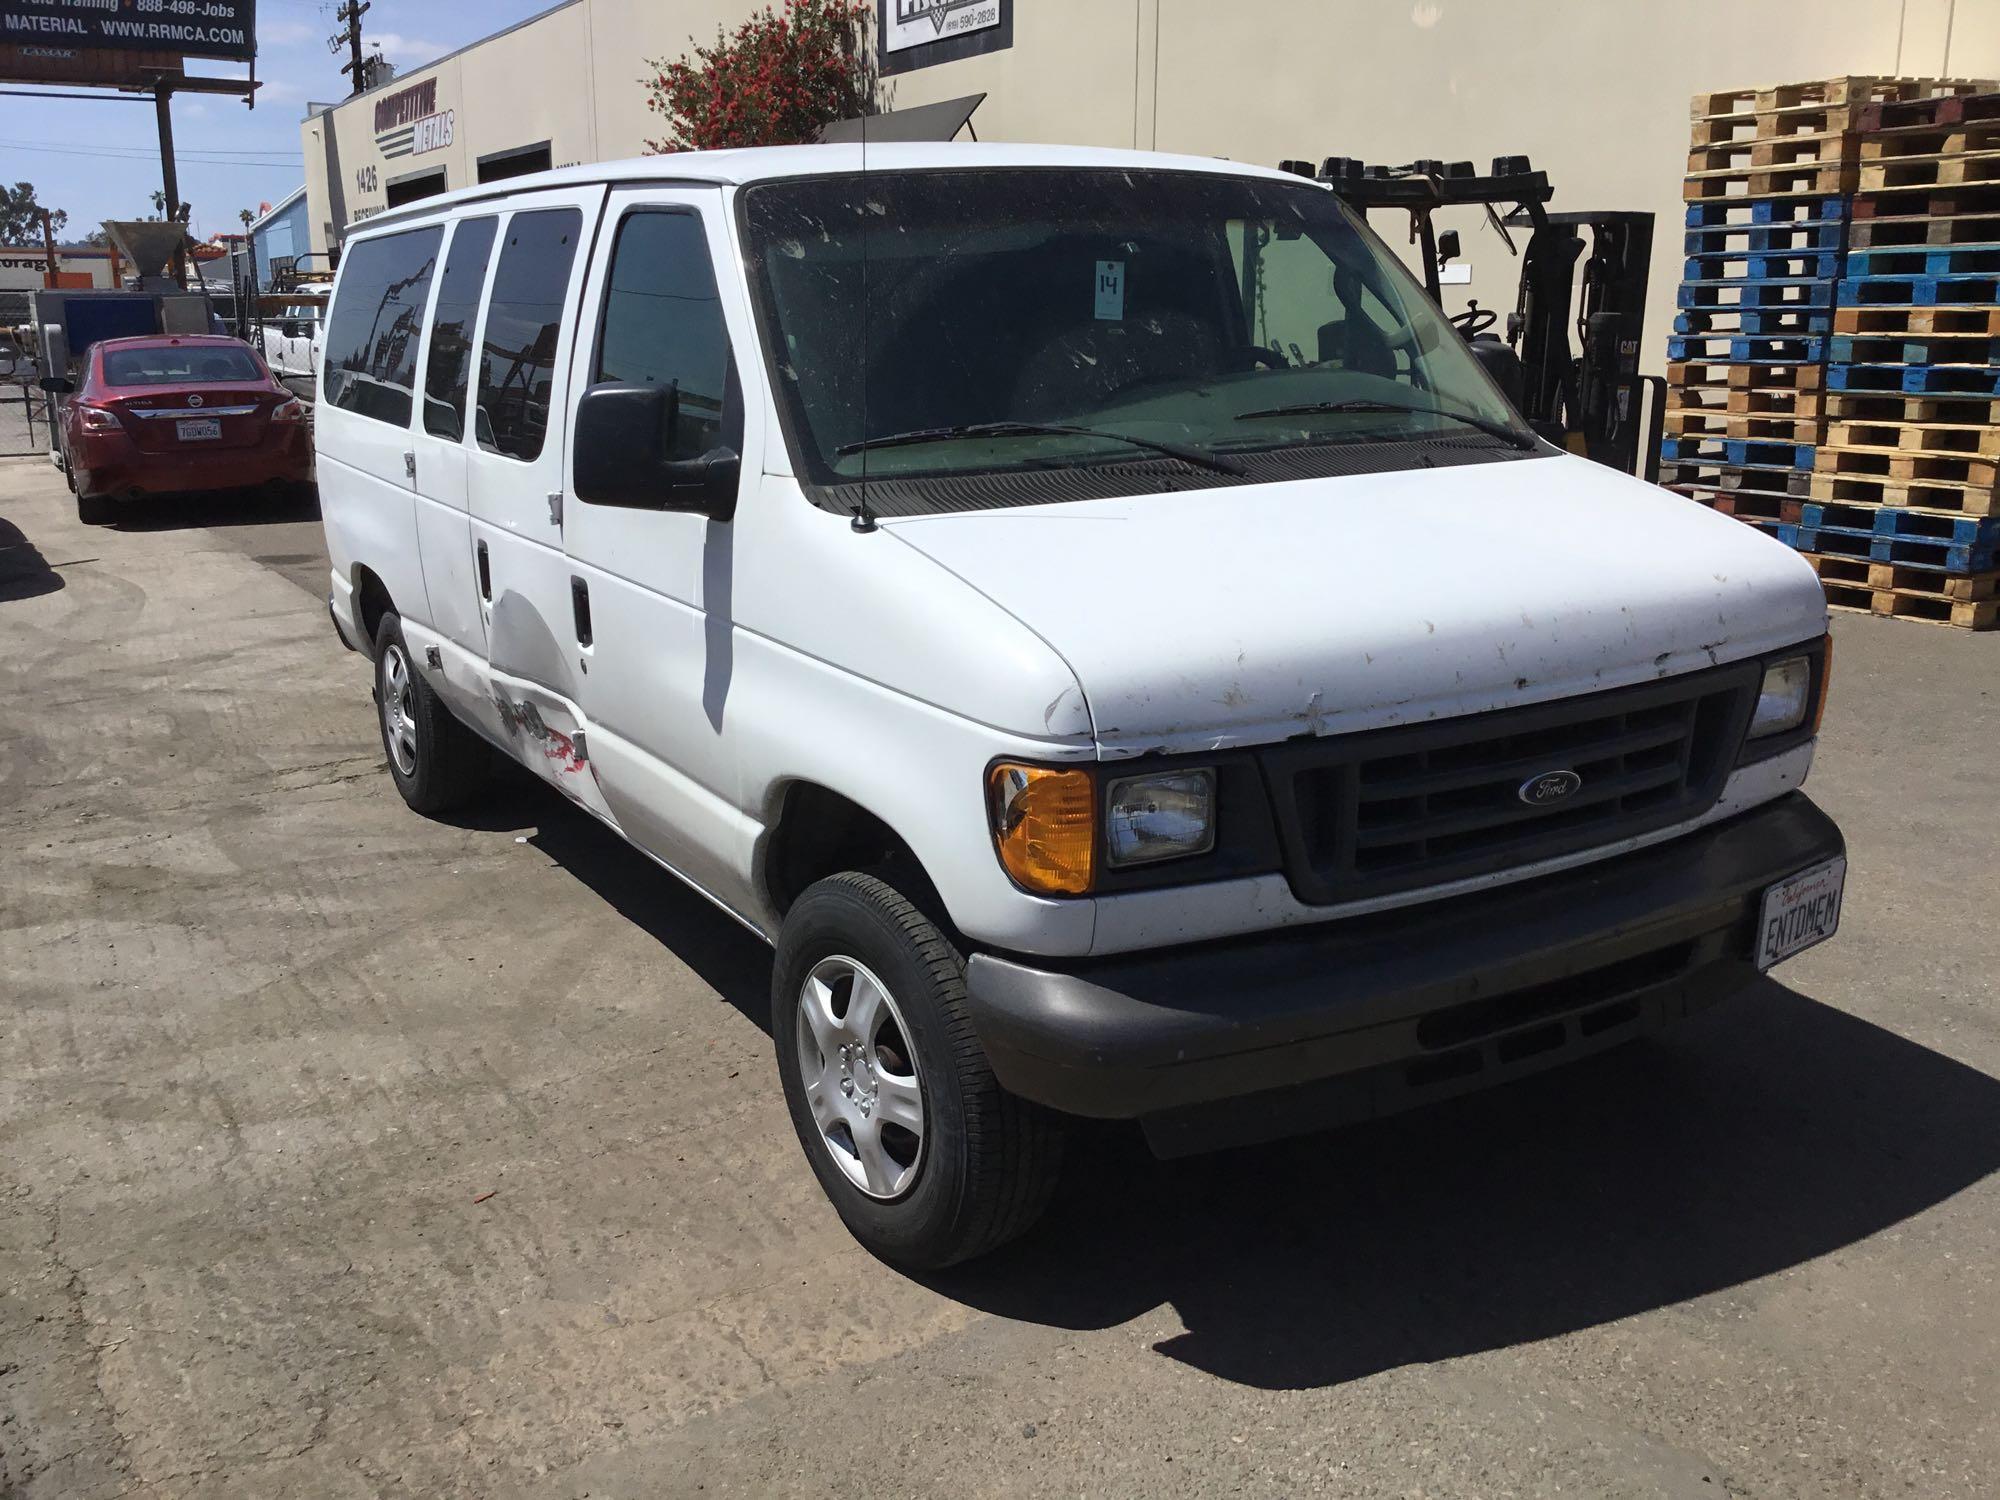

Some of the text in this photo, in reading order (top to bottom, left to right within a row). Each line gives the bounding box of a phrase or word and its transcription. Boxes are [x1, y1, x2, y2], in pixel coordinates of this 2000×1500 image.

[137, 0, 235, 18] 888-498-Jobs
[5, 14, 245, 44] MATERIAL WWW.RRMCA.COM
[374, 77, 437, 134] COMPETITIVE
[412, 109, 455, 155] METALS
[356, 165, 378, 194] 1426
[0, 258, 48, 272] orag
[1100, 274, 1118, 295] 14
[1620, 340, 1638, 354] CAT
[1536, 777, 1568, 798] Ford
